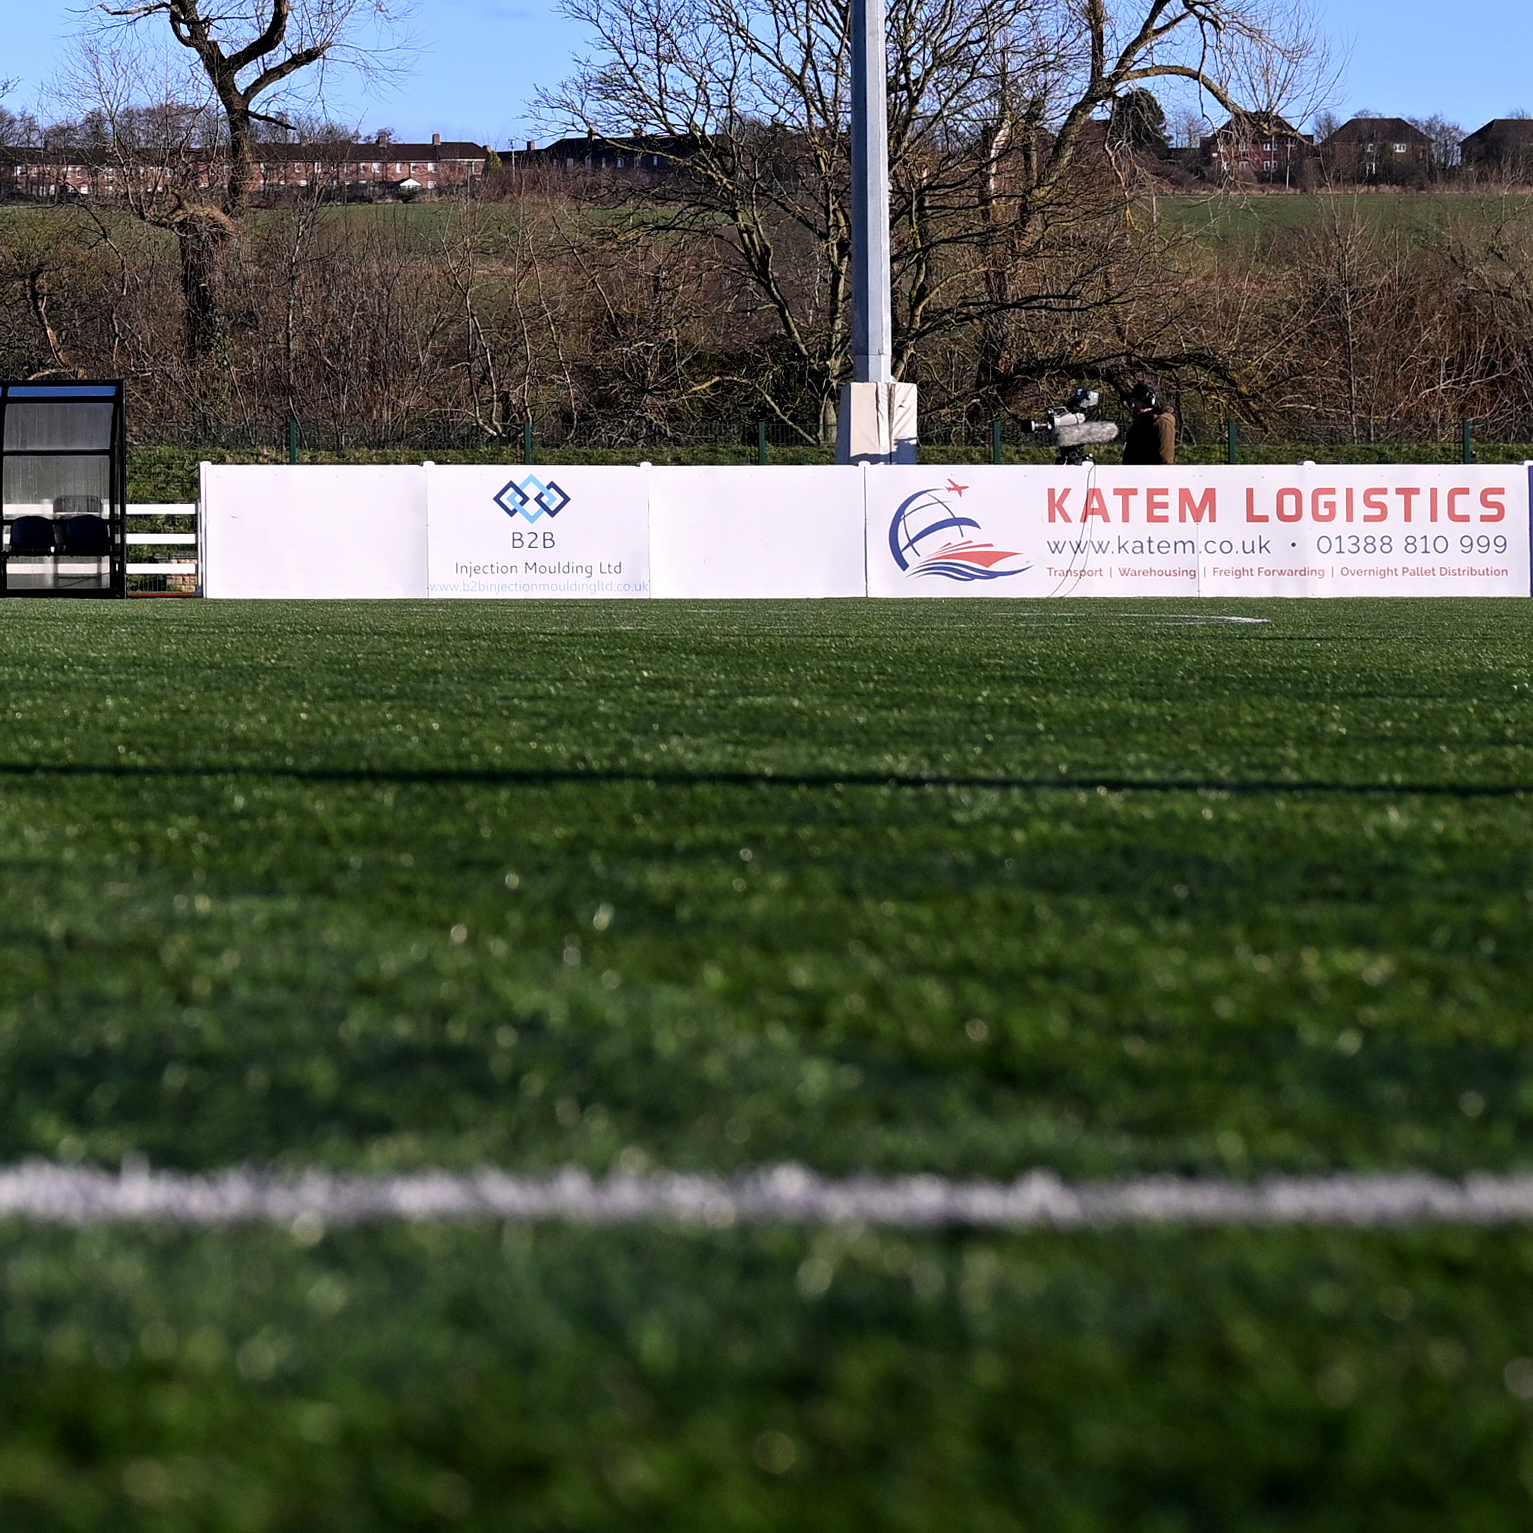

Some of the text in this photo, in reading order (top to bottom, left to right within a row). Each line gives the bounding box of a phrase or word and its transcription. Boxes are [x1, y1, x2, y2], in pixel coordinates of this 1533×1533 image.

[1047, 487, 1506, 523] KATEM LOGISTICS
[512, 532, 556, 549] B2B
[1047, 534, 1508, 555] www.katem.co.uk 01388 810 999
[456, 562, 622, 578] Injection Moulding Ltd
[1047, 566, 1509, 579] Transport Warehousing Freight Forwarding Overnight Pallet Distribution
[430, 580, 649, 595] www.b2binjectionmouldingltd.co.uk
